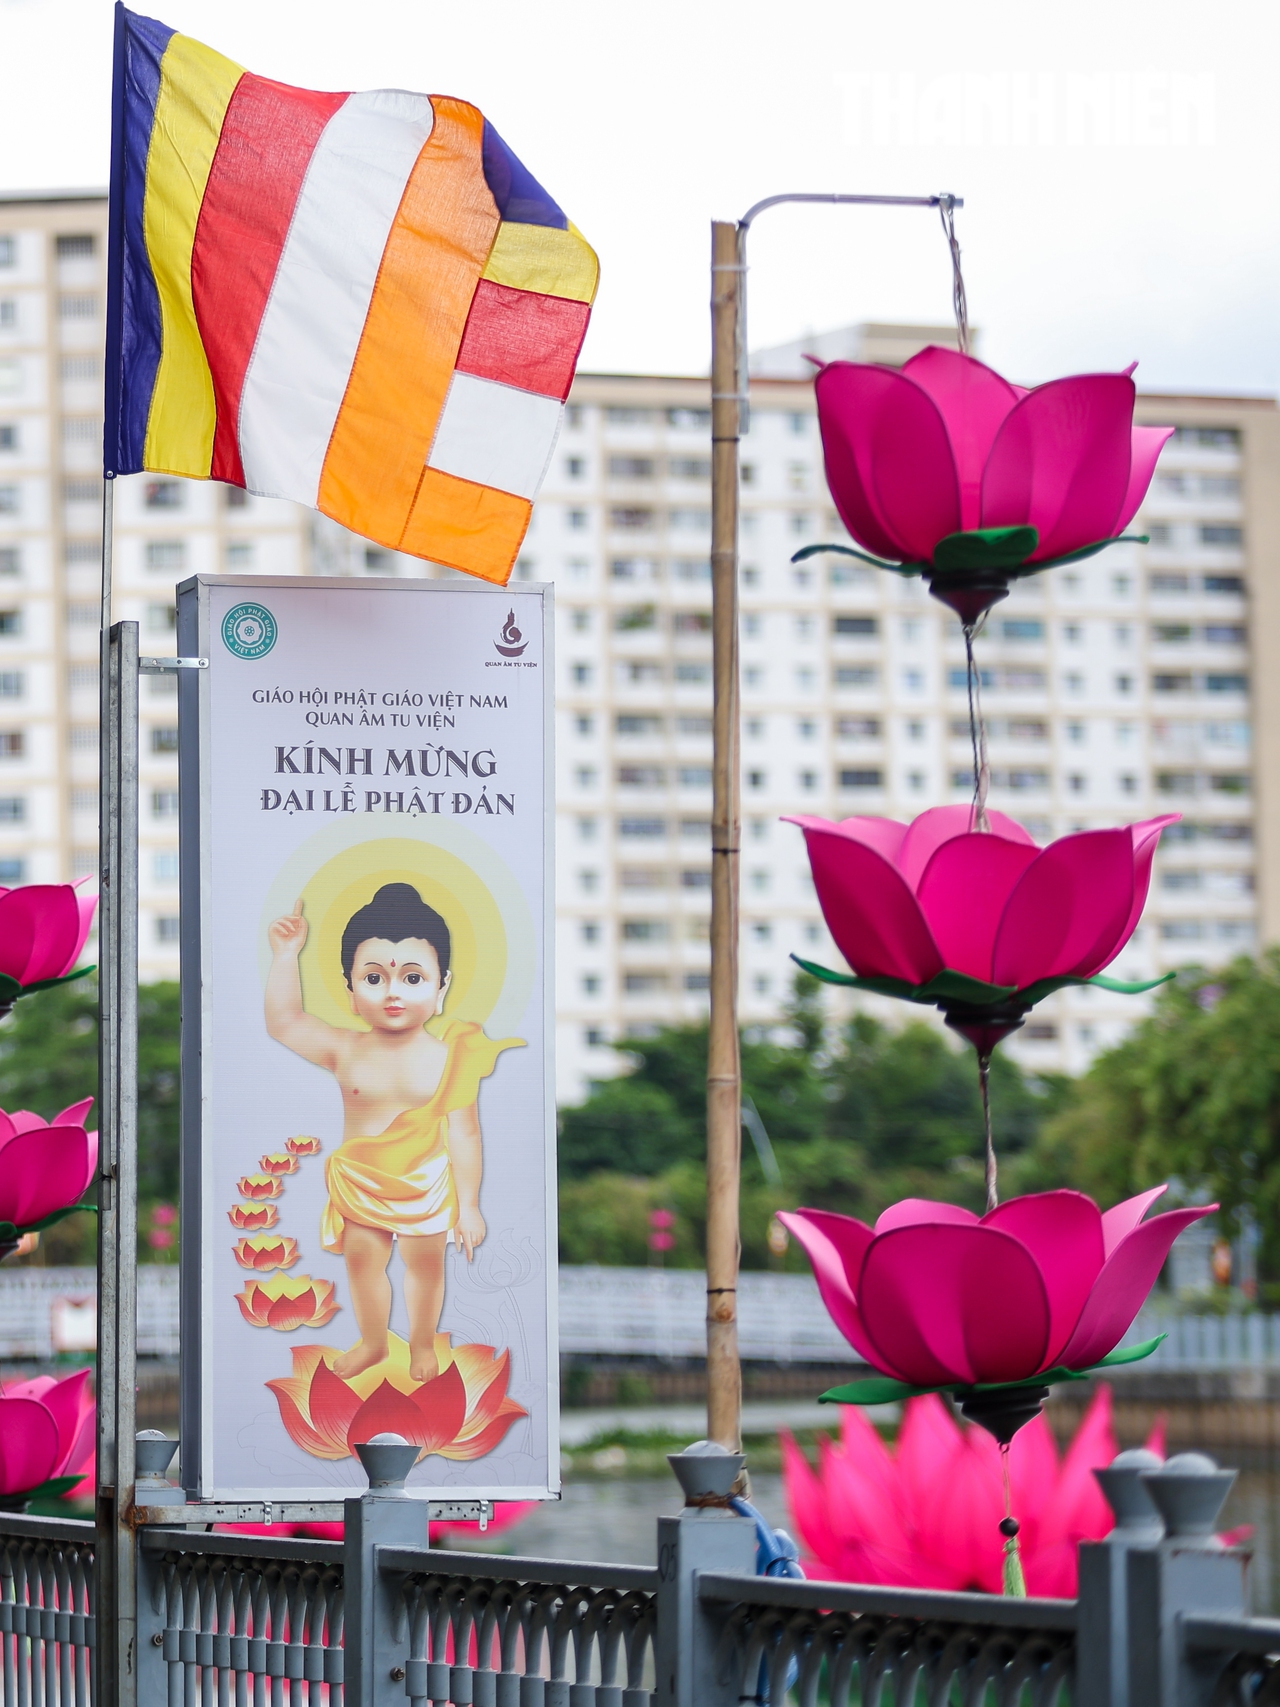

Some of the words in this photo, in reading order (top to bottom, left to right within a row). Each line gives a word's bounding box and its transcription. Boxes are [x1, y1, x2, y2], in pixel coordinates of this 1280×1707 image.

[252, 686, 294, 704] GIÁO
[299, 687, 328, 708] HỘI
[334, 688, 377, 709] PHẬT
[381, 689, 424, 707] GIÁO
[428, 690, 465, 711] VIỆT
[469, 694, 508, 709] NAM
[305, 711, 354, 728] QUAN
[359, 709, 385, 727] ÂM
[390, 713, 411, 728] TU
[415, 711, 455, 731] VIỆN
[273, 739, 374, 776] KÍNH
[382, 742, 498, 778] MỪNG
[260, 788, 316, 816] ĐẠI
[322, 781, 358, 814] LỄ
[363, 785, 447, 819] PHẬT
[451, 784, 516, 816] ĐẢN
